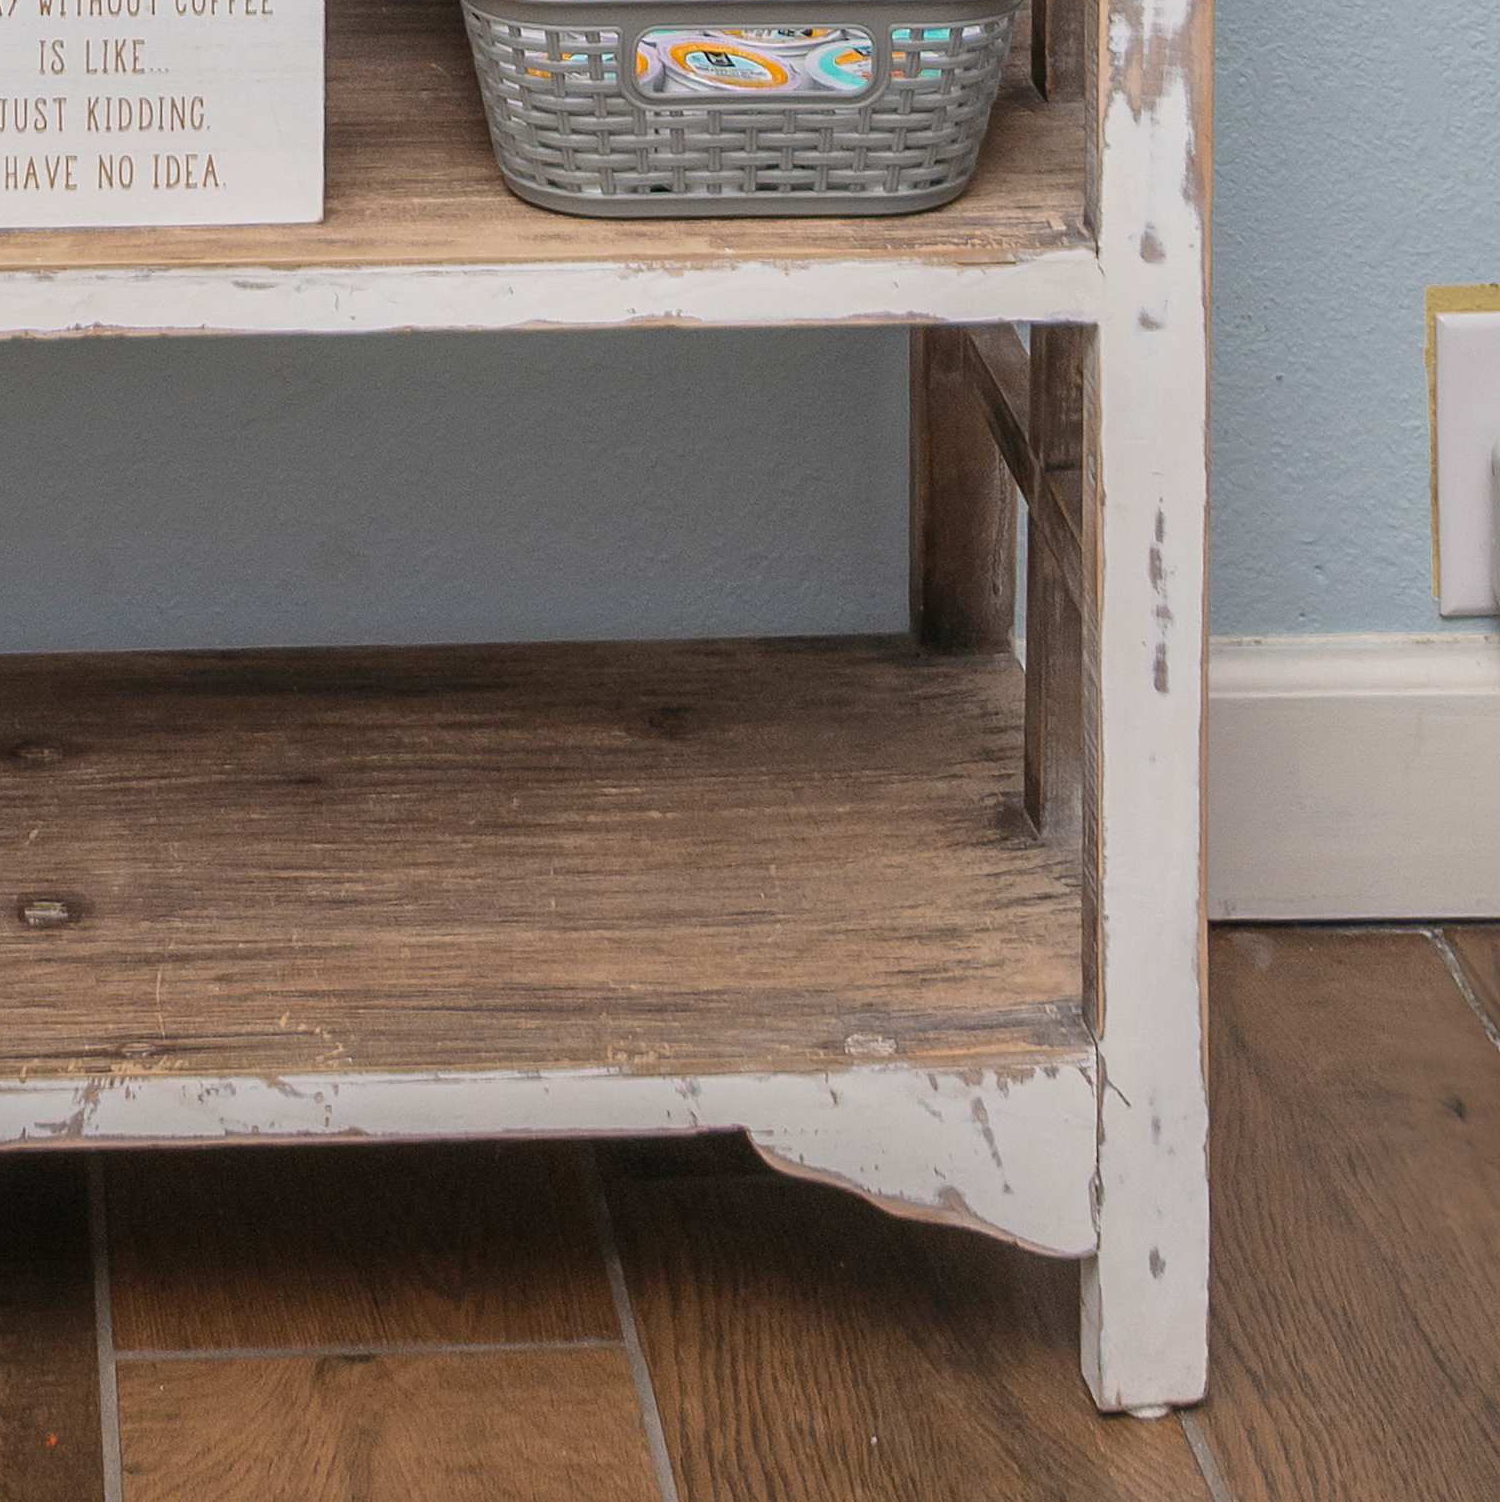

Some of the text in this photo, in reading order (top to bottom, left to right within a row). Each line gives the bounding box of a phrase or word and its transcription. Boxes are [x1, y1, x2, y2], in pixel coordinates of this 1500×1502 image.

[38, 38, 170, 75] IS LIKE...
[86, 96, 212, 133] KIDDING.
[4, 154, 79, 191] HAVE
[98, 154, 134, 190] NO
[152, 153, 227, 190] IDEA.
